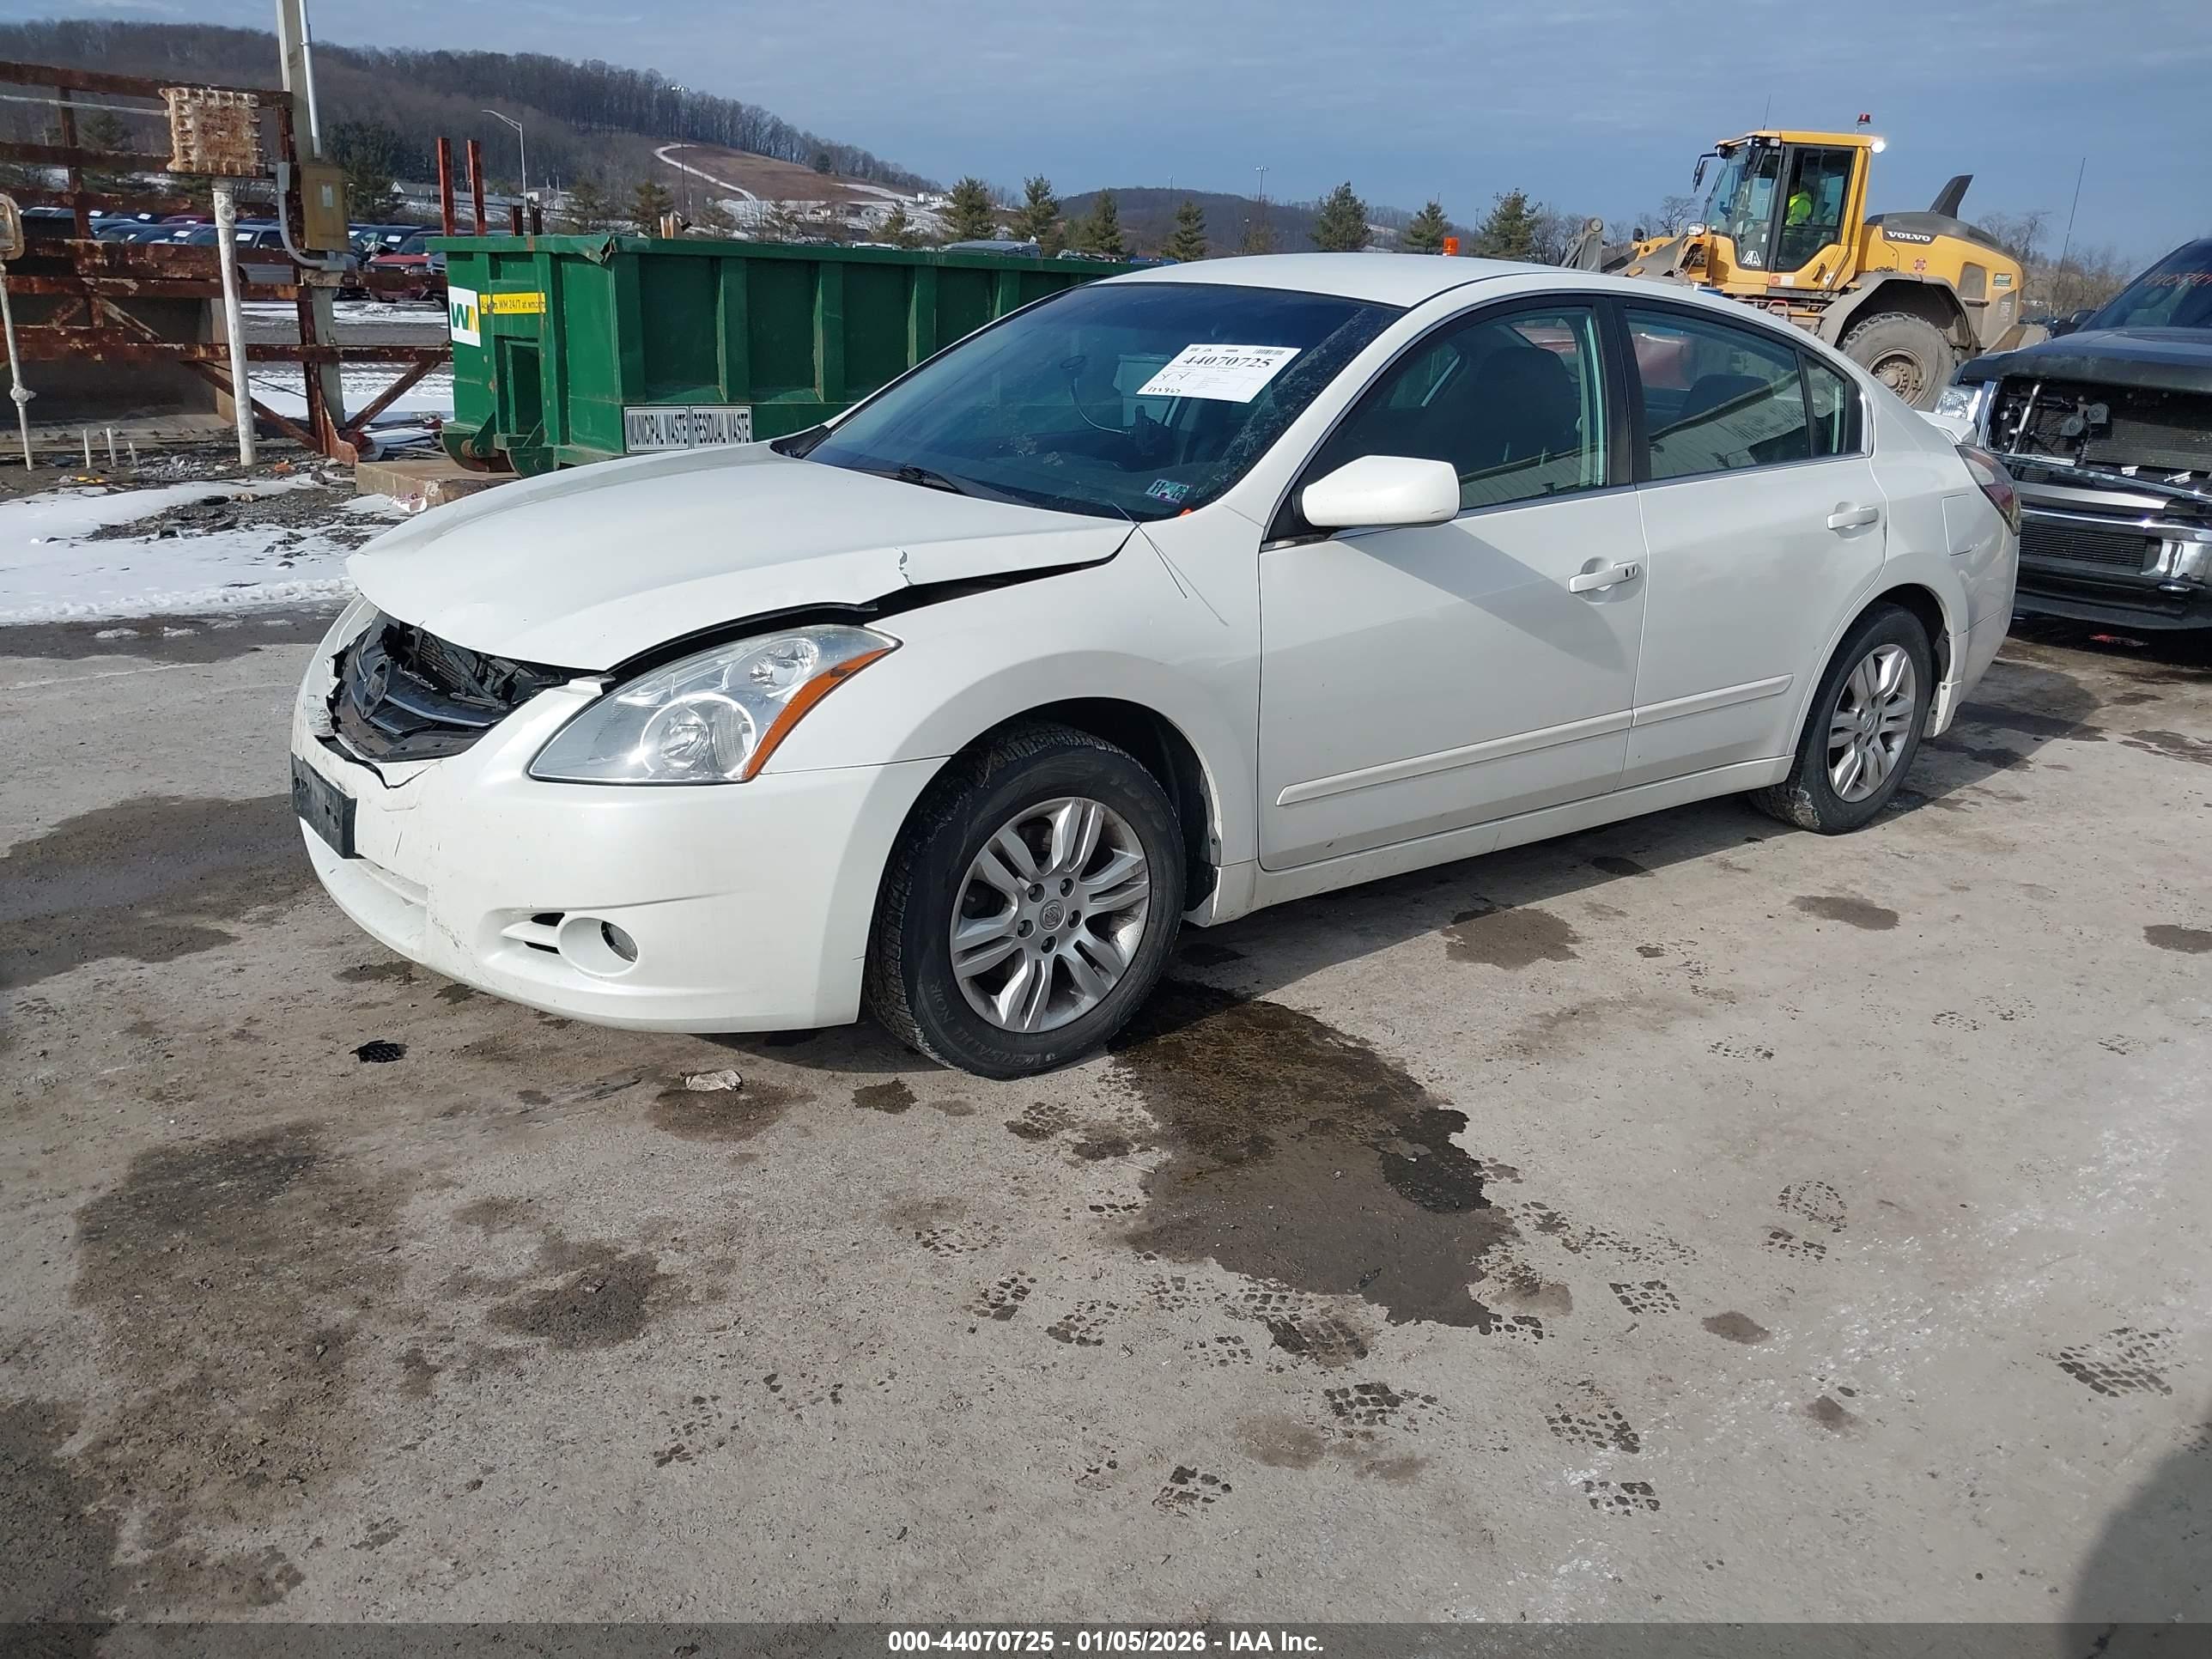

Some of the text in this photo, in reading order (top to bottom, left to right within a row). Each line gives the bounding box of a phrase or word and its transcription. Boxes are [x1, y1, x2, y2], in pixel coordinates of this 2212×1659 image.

[1887, 231, 1930, 241] VOLVO
[1183, 356, 1273, 368] 44070725
[629, 413, 687, 446] MUNICIPAL WASTE
[694, 413, 749, 444] RESIDUAL WASTE
